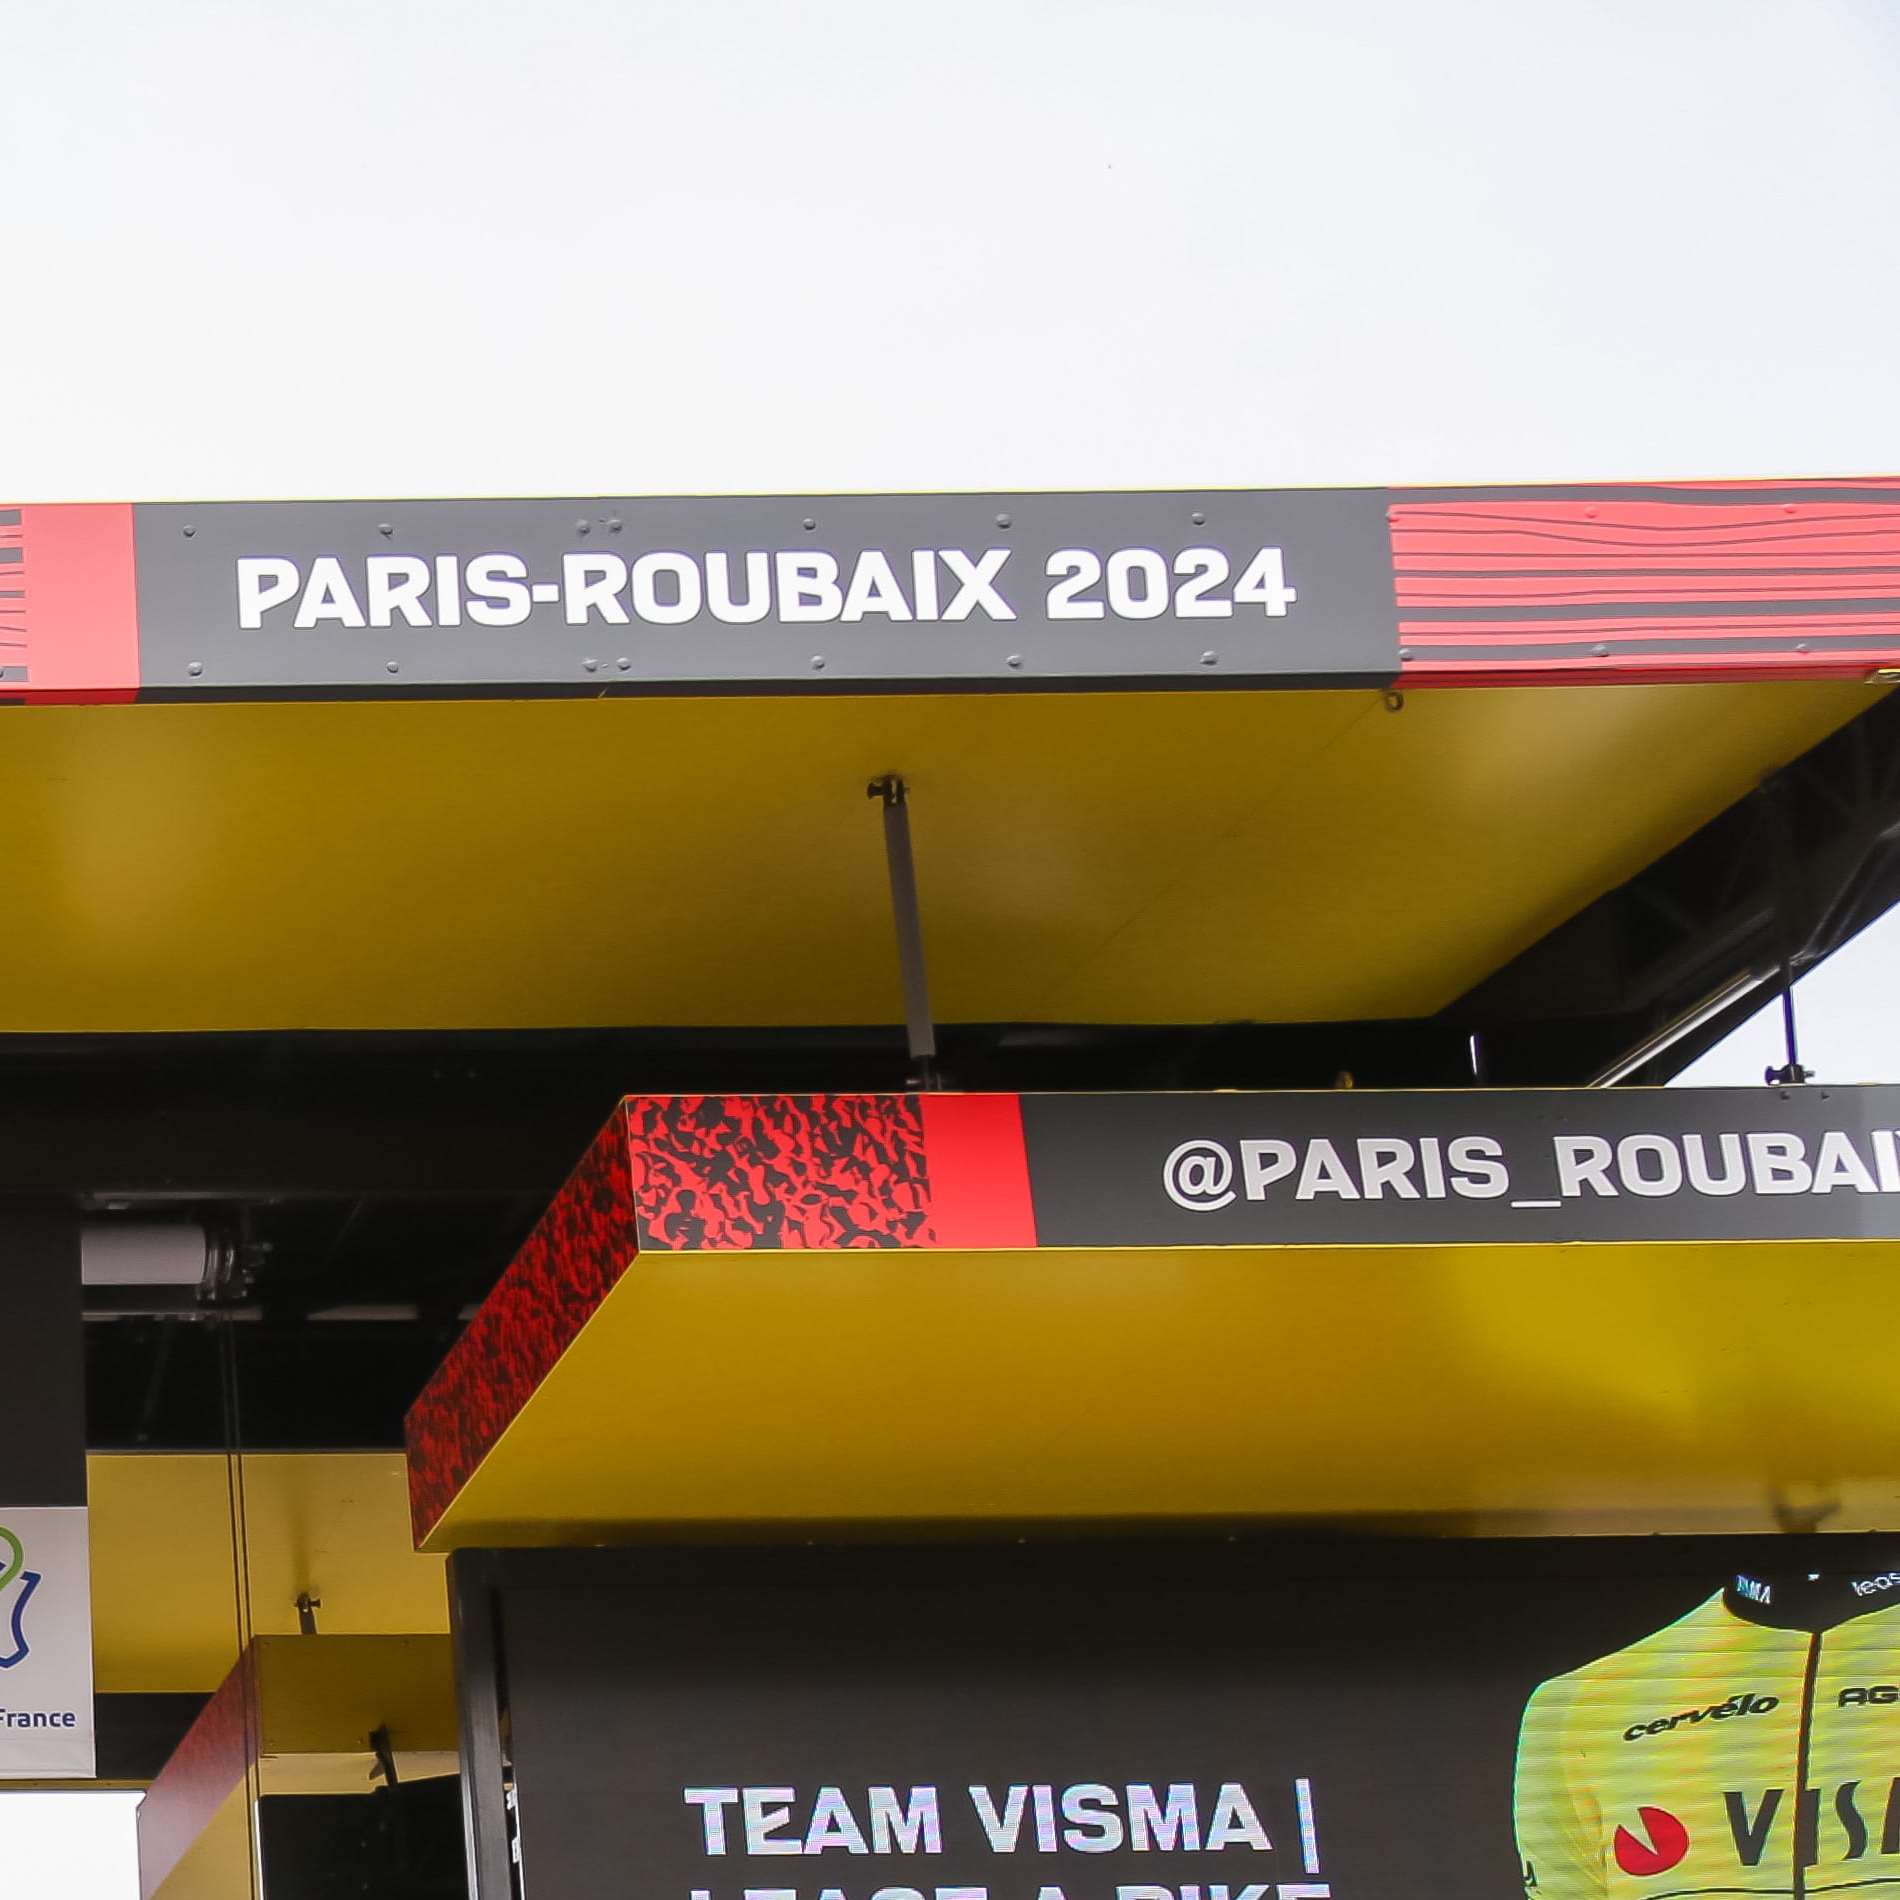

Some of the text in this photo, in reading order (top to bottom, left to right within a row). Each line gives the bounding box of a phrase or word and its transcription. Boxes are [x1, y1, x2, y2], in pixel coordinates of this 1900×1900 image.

[235, 547, 1297, 630] PARIS-ROUBAIX 2024
[1163, 1128, 1900, 1212] @PARIS_ROUBAI
[1623, 1693, 1780, 1742] cervélo
[683, 1786, 943, 1856] TEAM
[968, 1783, 1273, 1854] VISMA
